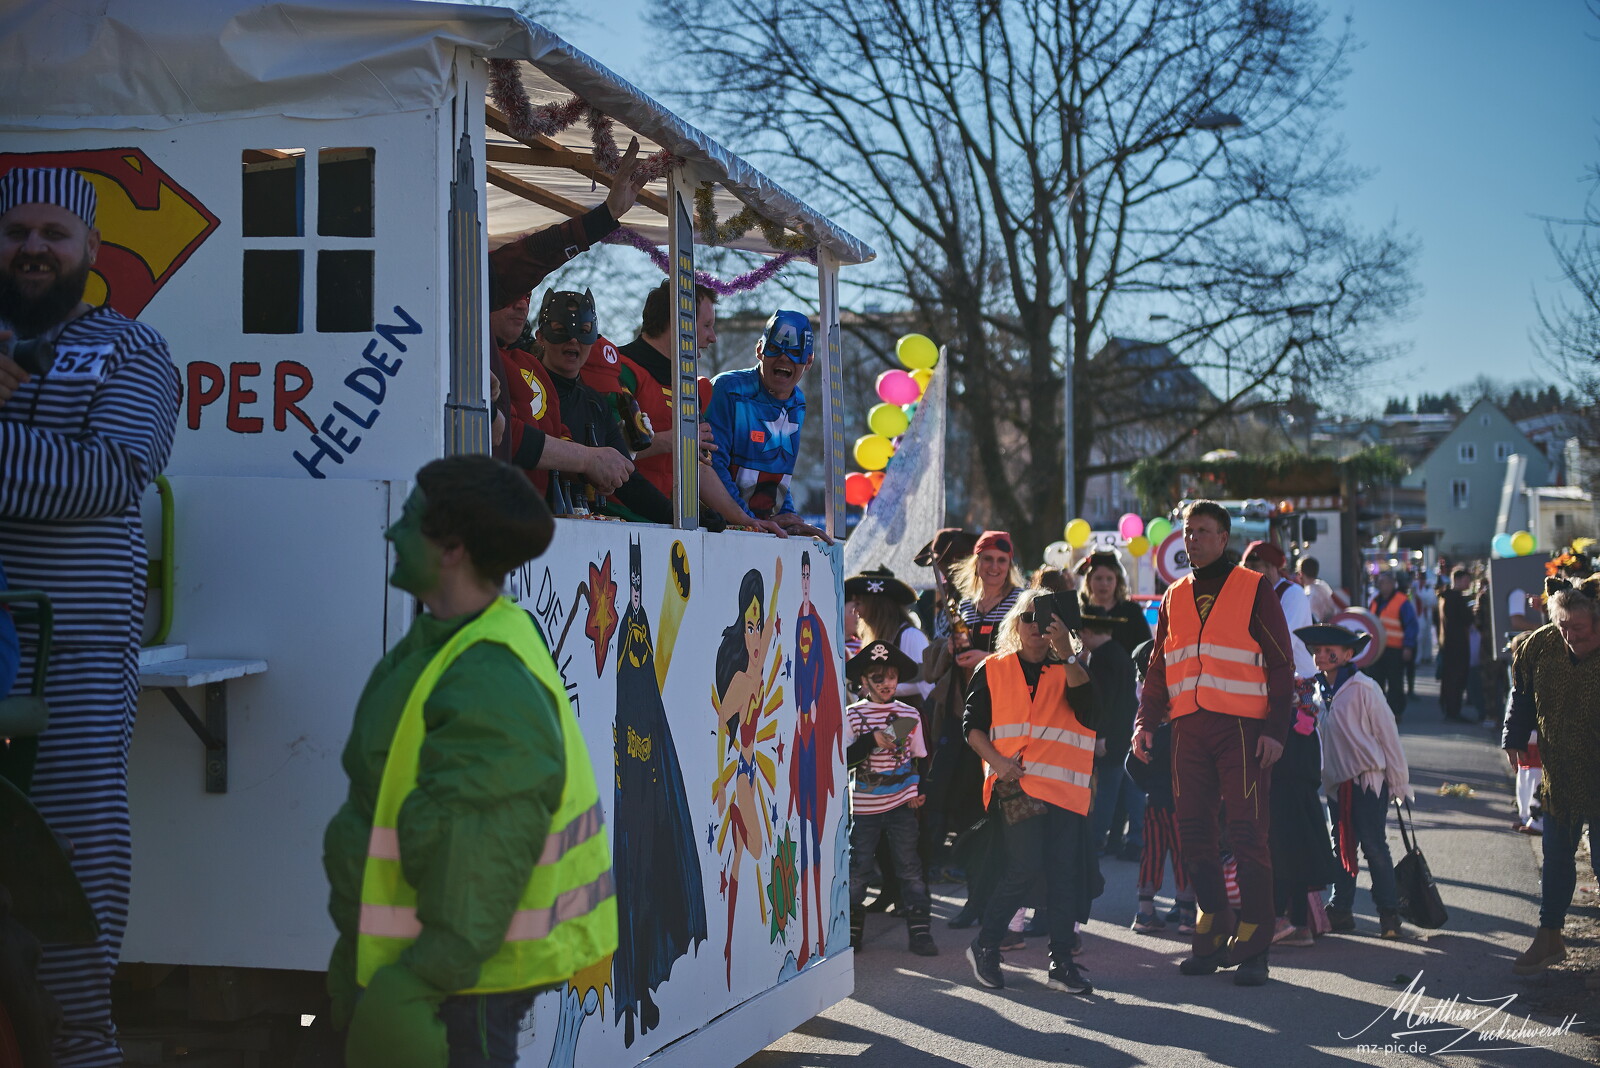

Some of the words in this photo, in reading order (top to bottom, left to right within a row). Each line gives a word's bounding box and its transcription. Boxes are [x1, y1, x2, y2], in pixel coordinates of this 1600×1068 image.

[774, 323, 799, 347] A
[175, 360, 319, 434] PER
[292, 305, 423, 479] HELDEN
[535, 565, 564, 646] DIE
[773, 828, 798, 932] OH
